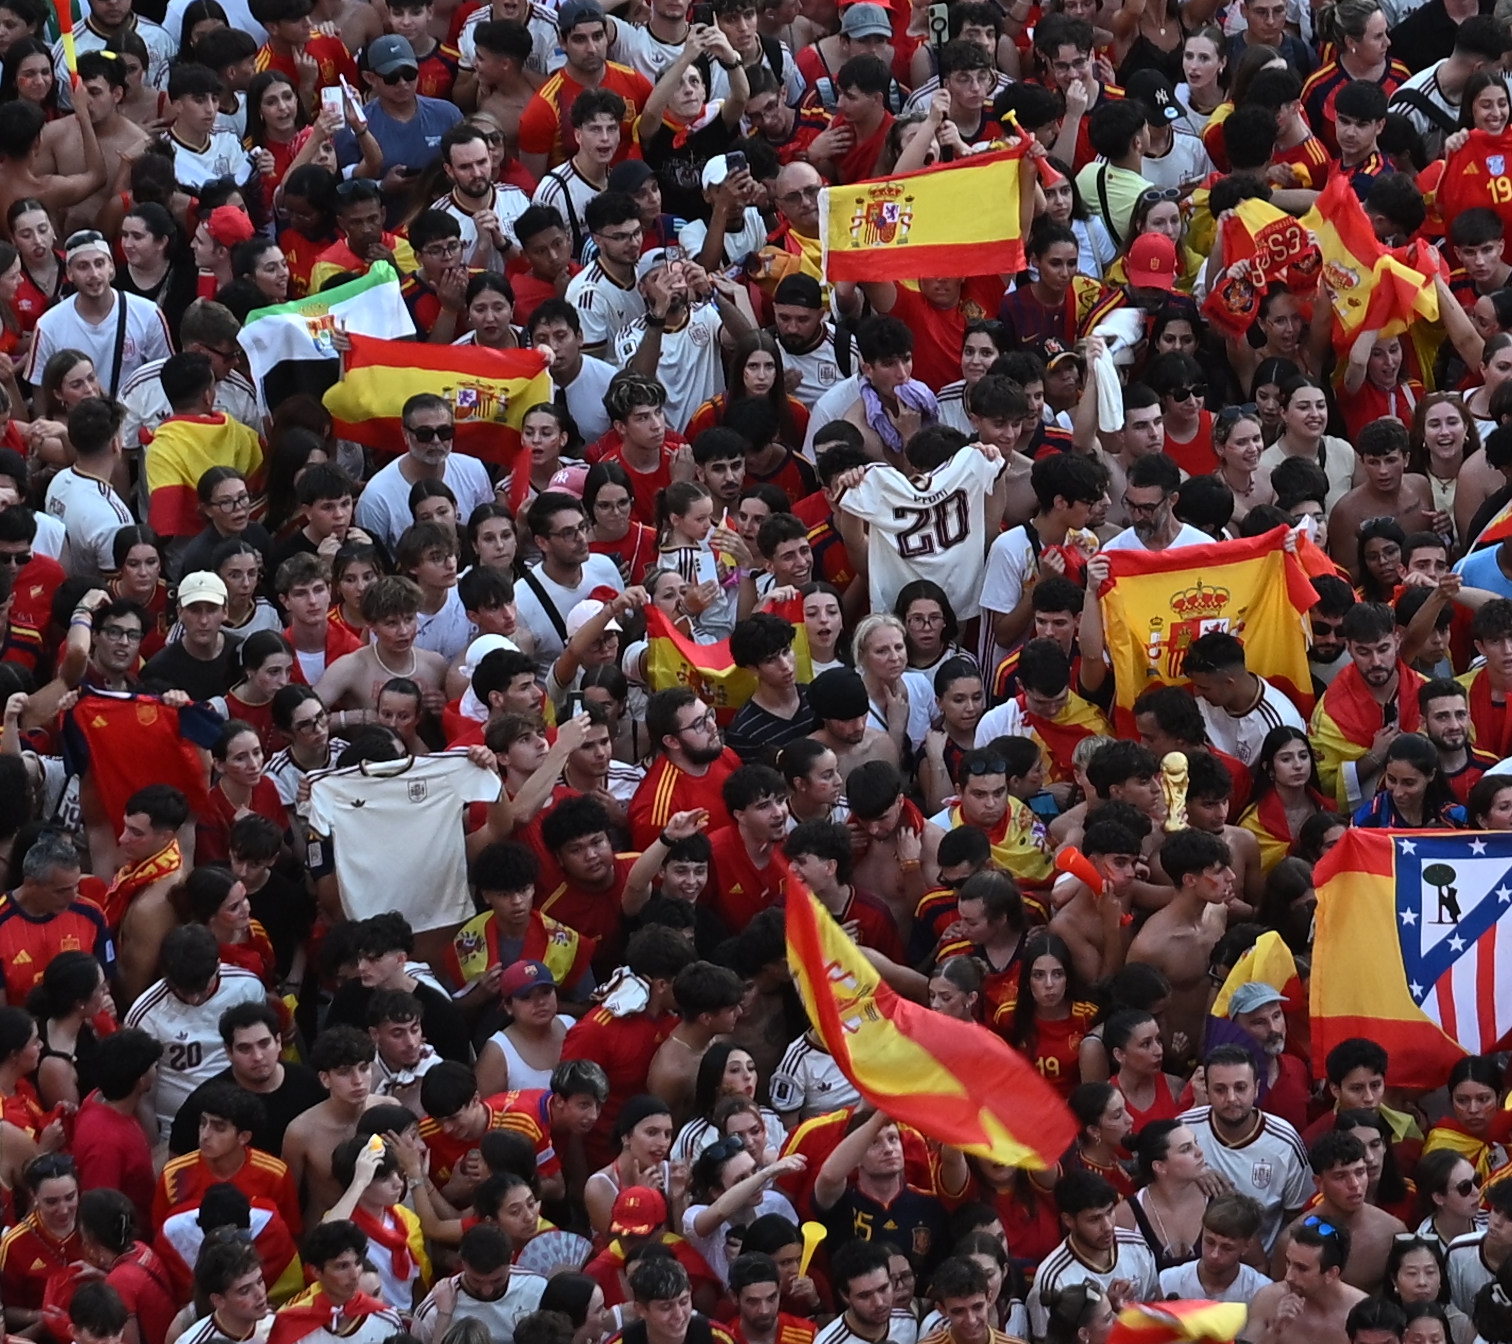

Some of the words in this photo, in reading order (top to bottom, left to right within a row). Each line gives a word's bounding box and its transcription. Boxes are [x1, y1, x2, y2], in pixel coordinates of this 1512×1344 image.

[1486, 175, 1512, 205] 19
[892, 488, 970, 559] 20
[169, 1042, 202, 1071] 20
